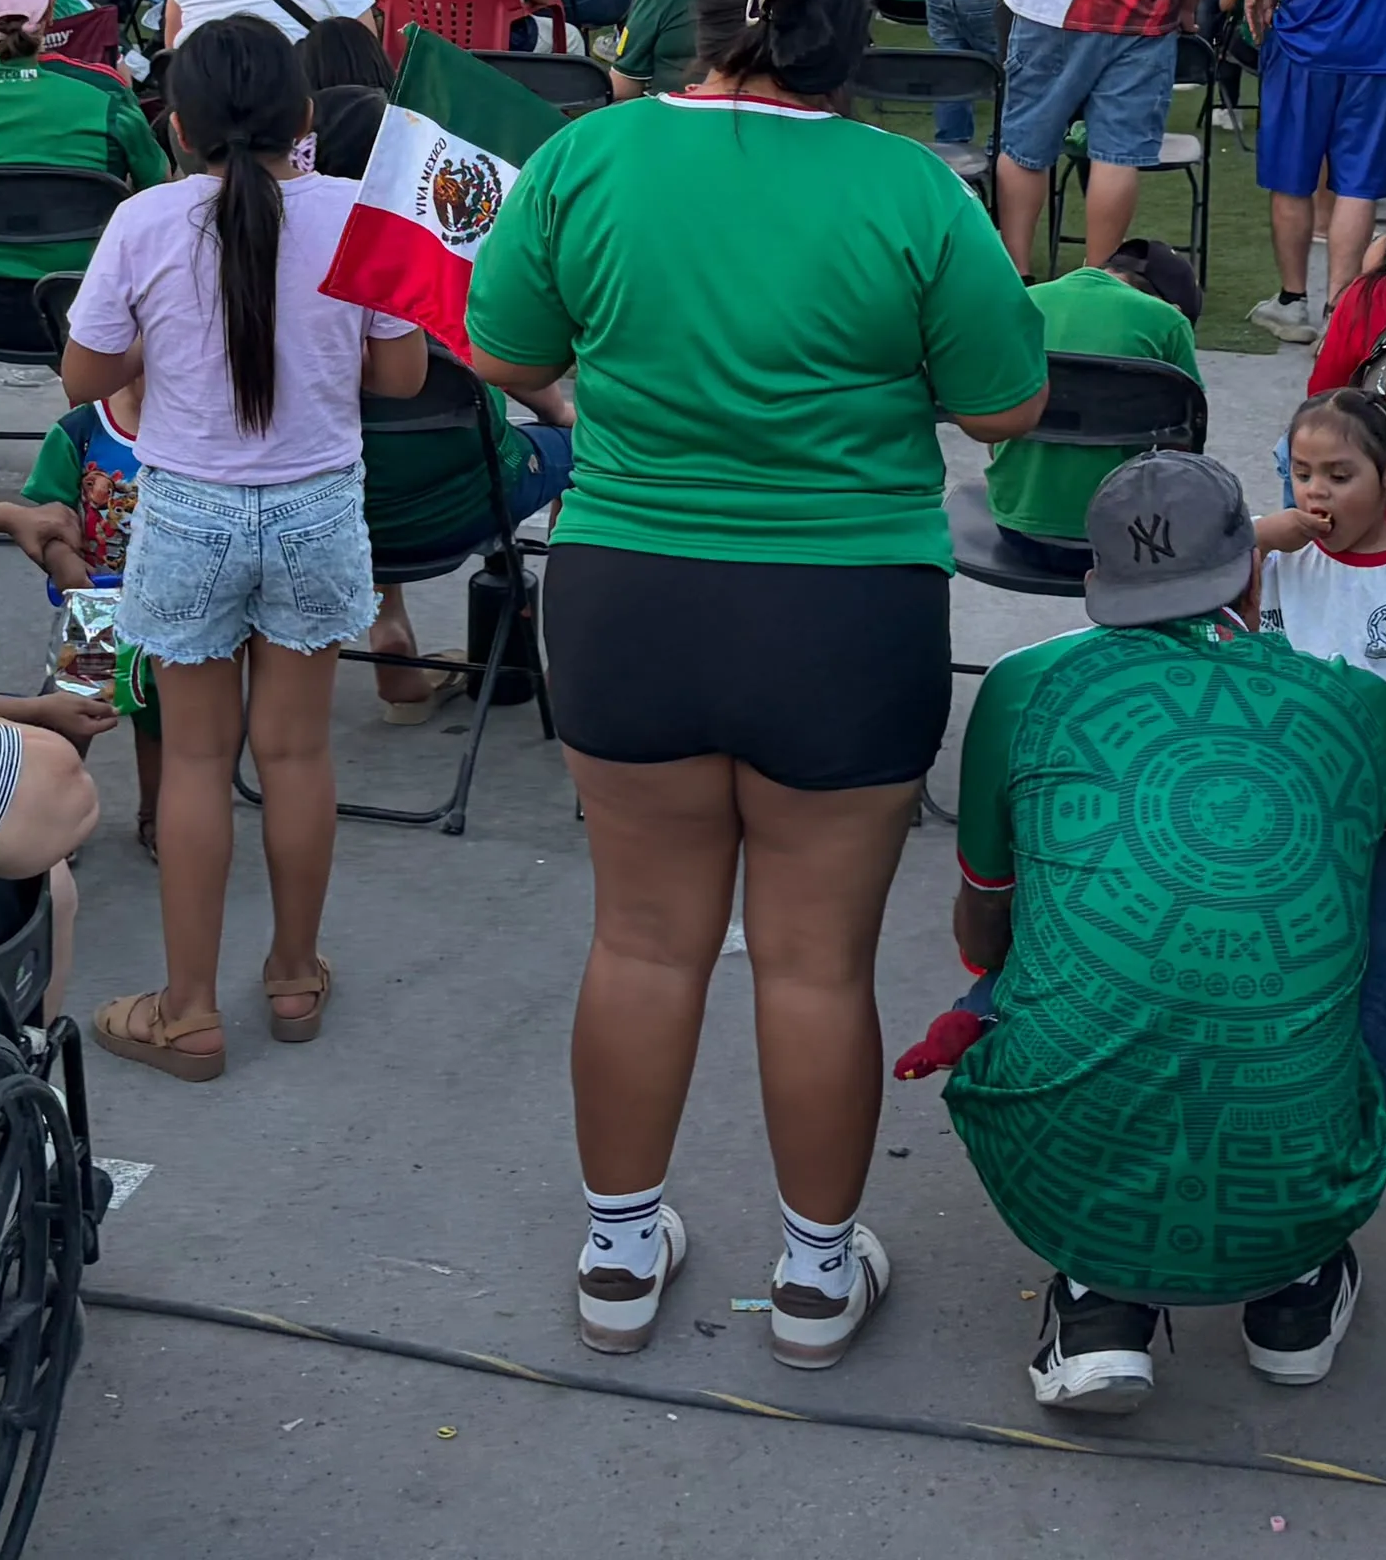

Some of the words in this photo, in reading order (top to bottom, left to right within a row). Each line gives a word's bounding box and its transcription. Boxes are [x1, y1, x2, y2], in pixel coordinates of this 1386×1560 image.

[421, 137, 447, 183] MEXICO
[416, 186, 429, 216] VIVA
[1127, 513, 1176, 564] NY
